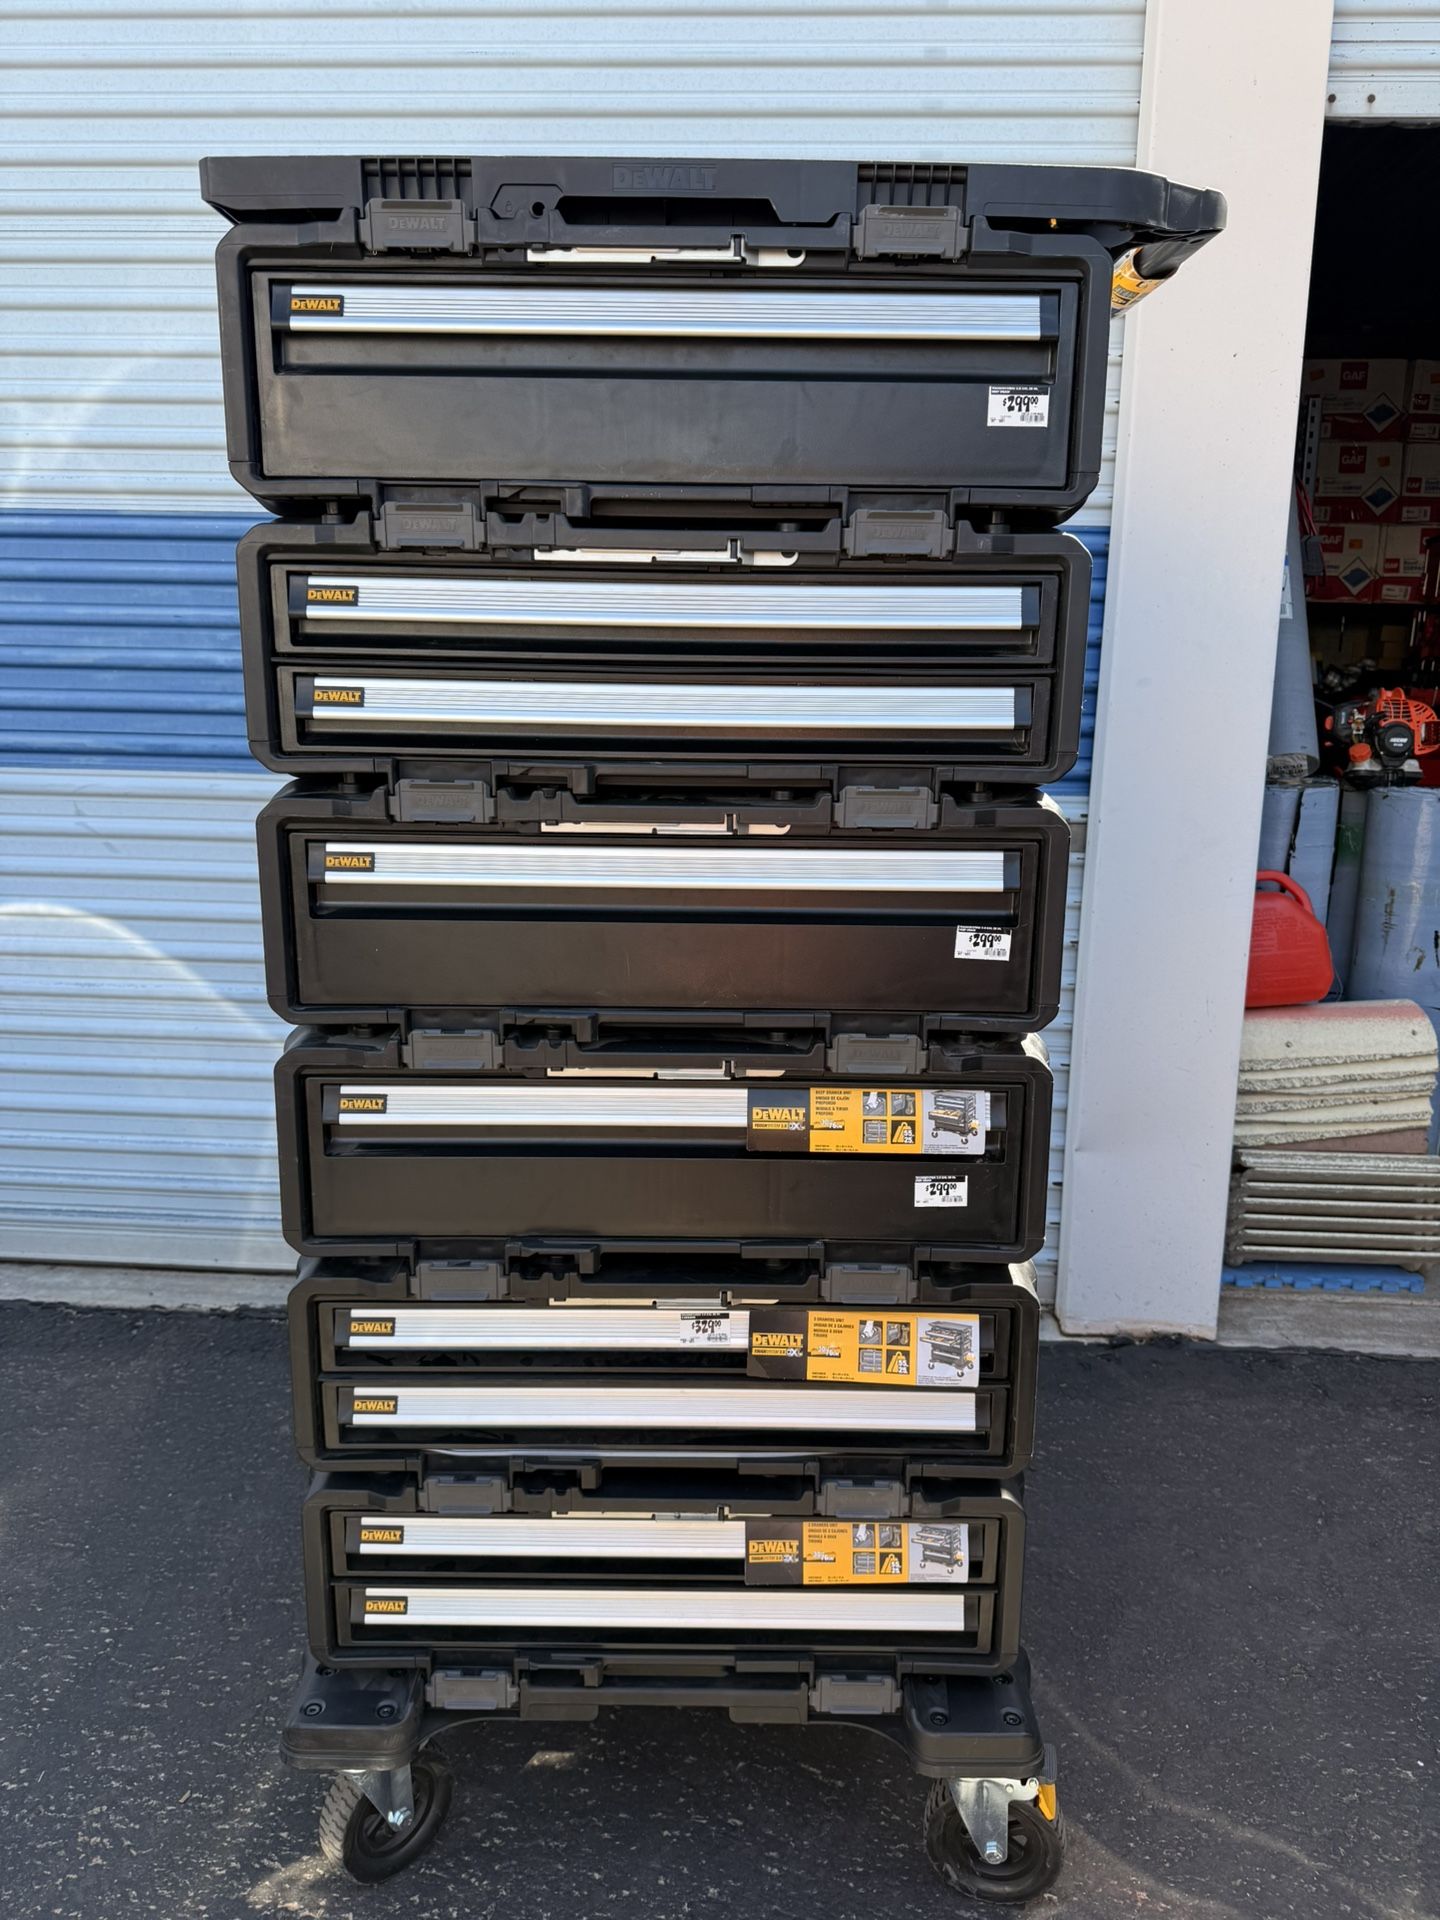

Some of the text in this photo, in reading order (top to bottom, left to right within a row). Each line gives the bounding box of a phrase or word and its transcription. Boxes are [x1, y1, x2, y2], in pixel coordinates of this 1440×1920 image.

[613, 166, 718, 190] DEWALT
[388, 216, 448, 231] DEWALT
[291, 298, 341, 311] DEWALT
[1342, 370, 1368, 382] GAF
[1341, 456, 1366, 465] GAF
[401, 518, 458, 530] DEWALT
[307, 588, 355, 601] DEWALT
[314, 689, 361, 703] DEWALT
[325, 855, 372, 868] DEWALT
[340, 1098, 384, 1110] DEWALT
[752, 1107, 805, 1121] DEWALT
[350, 1321, 393, 1333] DEWALT
[752, 1332, 804, 1347] DEWALT
[353, 1399, 396, 1412] DEWALT
[361, 1529, 402, 1542] DEWALT
[749, 1540, 799, 1554] DEWALT
[365, 1600, 406, 1612] DEWALT
